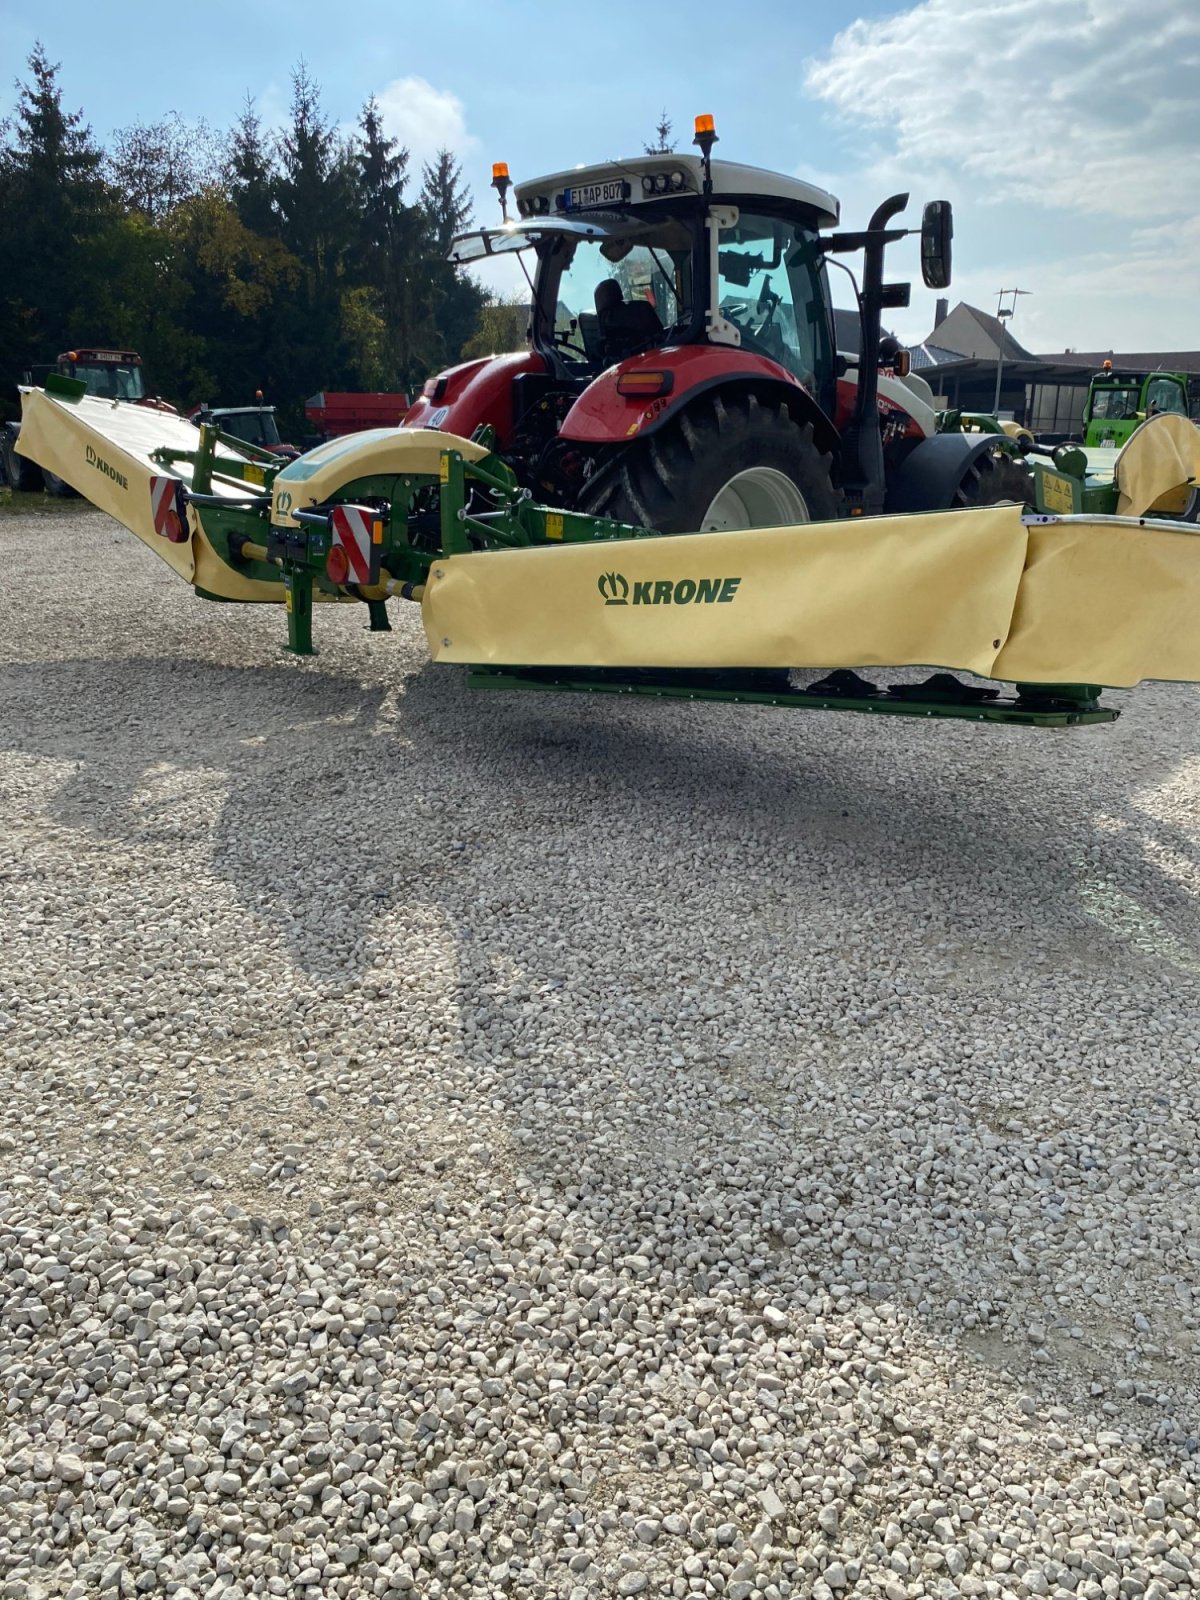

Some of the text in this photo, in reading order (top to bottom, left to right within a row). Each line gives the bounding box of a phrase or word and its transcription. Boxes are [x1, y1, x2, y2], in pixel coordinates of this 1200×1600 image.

[571, 183, 621, 206] EI AP 807
[878, 367, 896, 380] EYR
[96, 456, 129, 491] KRONE
[632, 577, 742, 605] KRONE
